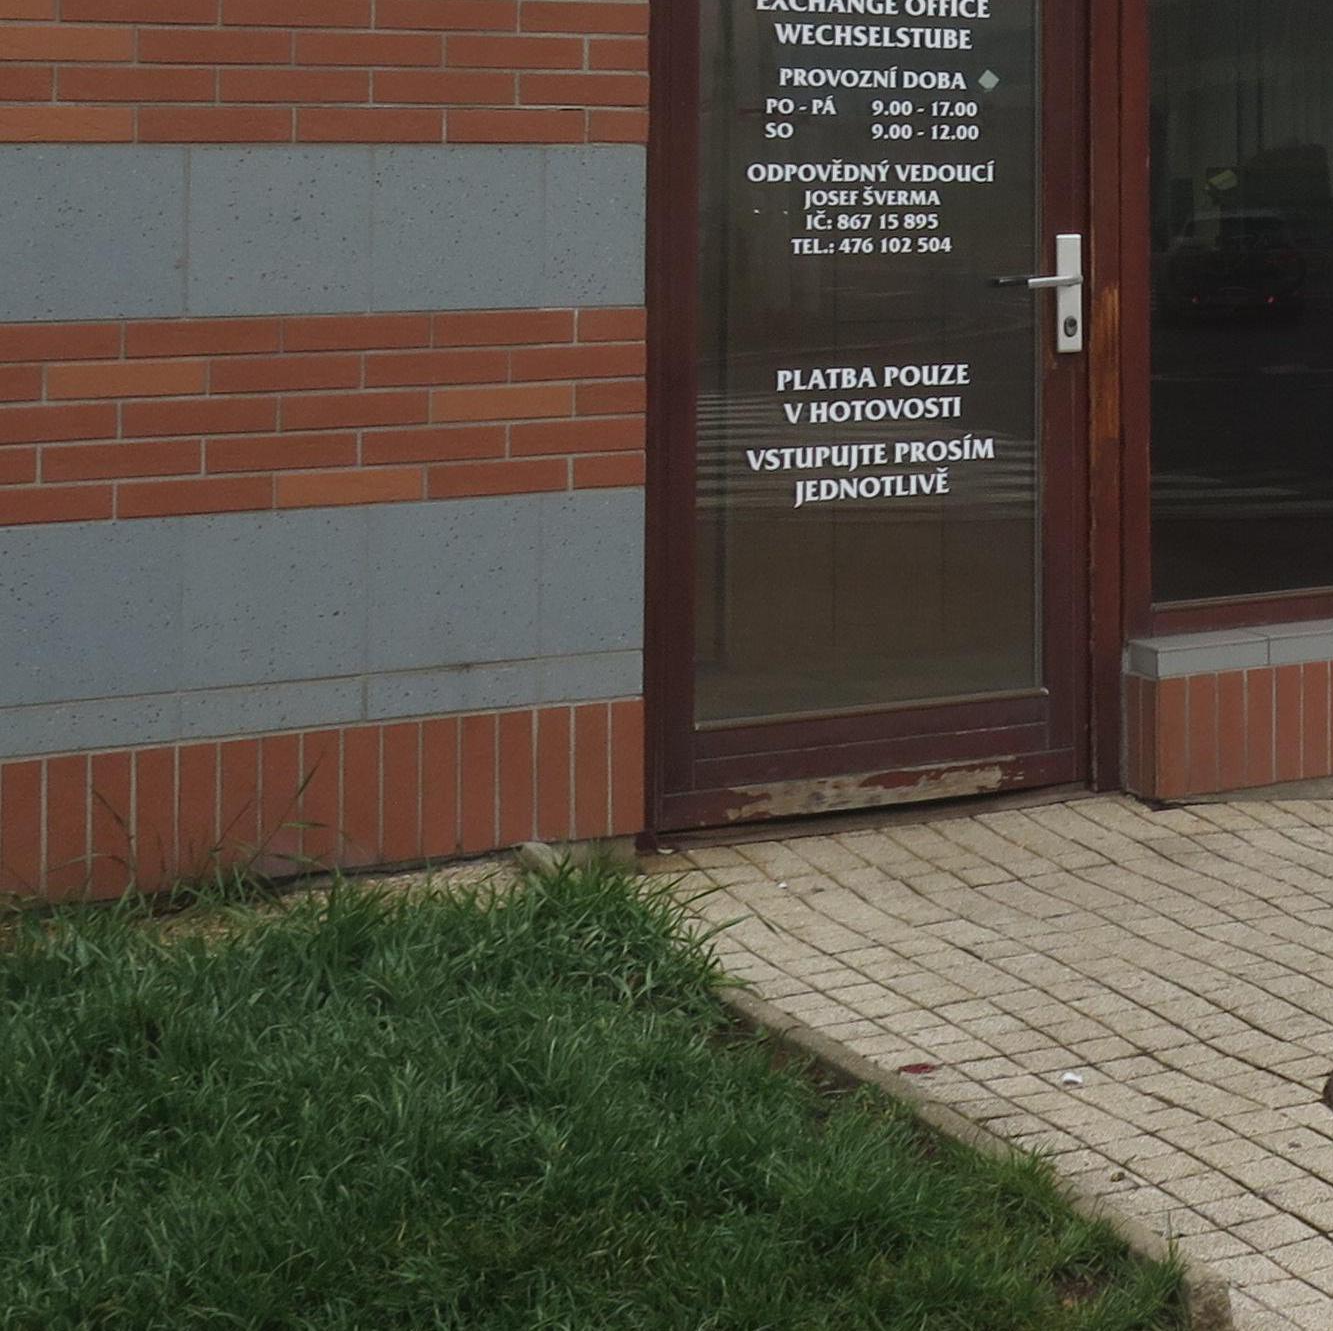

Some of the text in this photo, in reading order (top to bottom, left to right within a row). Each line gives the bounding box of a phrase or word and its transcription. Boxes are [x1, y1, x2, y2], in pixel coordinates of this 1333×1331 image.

[775, 24, 972, 49] WECHSELSTUBE
[780, 67, 966, 89] PROVOZNÍ DOBA
[767, 99, 794, 114] PO
[812, 96, 836, 114] PÁ
[872, 100, 912, 115] 9.00
[932, 102, 977, 116] 17.00
[765, 123, 793, 138] SO
[872, 124, 912, 139] 9.00
[932, 125, 979, 140] 12.00
[747, 159, 994, 182] ODPOVĚDNÝ VEDOUCÍ
[804, 186, 940, 209] JOSEF ŠVERMA
[806, 209, 938, 230] IČ: 867 15 895
[839, 238, 873, 253] 476
[881, 238, 912, 253] 102
[918, 237, 952, 252] 504
[777, 365, 970, 391] PLATBA POUZE
[784, 397, 960, 423] V HOTOVOSTI
[747, 434, 994, 471] VSTUPUJTE PROSÍM
[795, 466, 949, 507] JEDNOTLIVĚ
